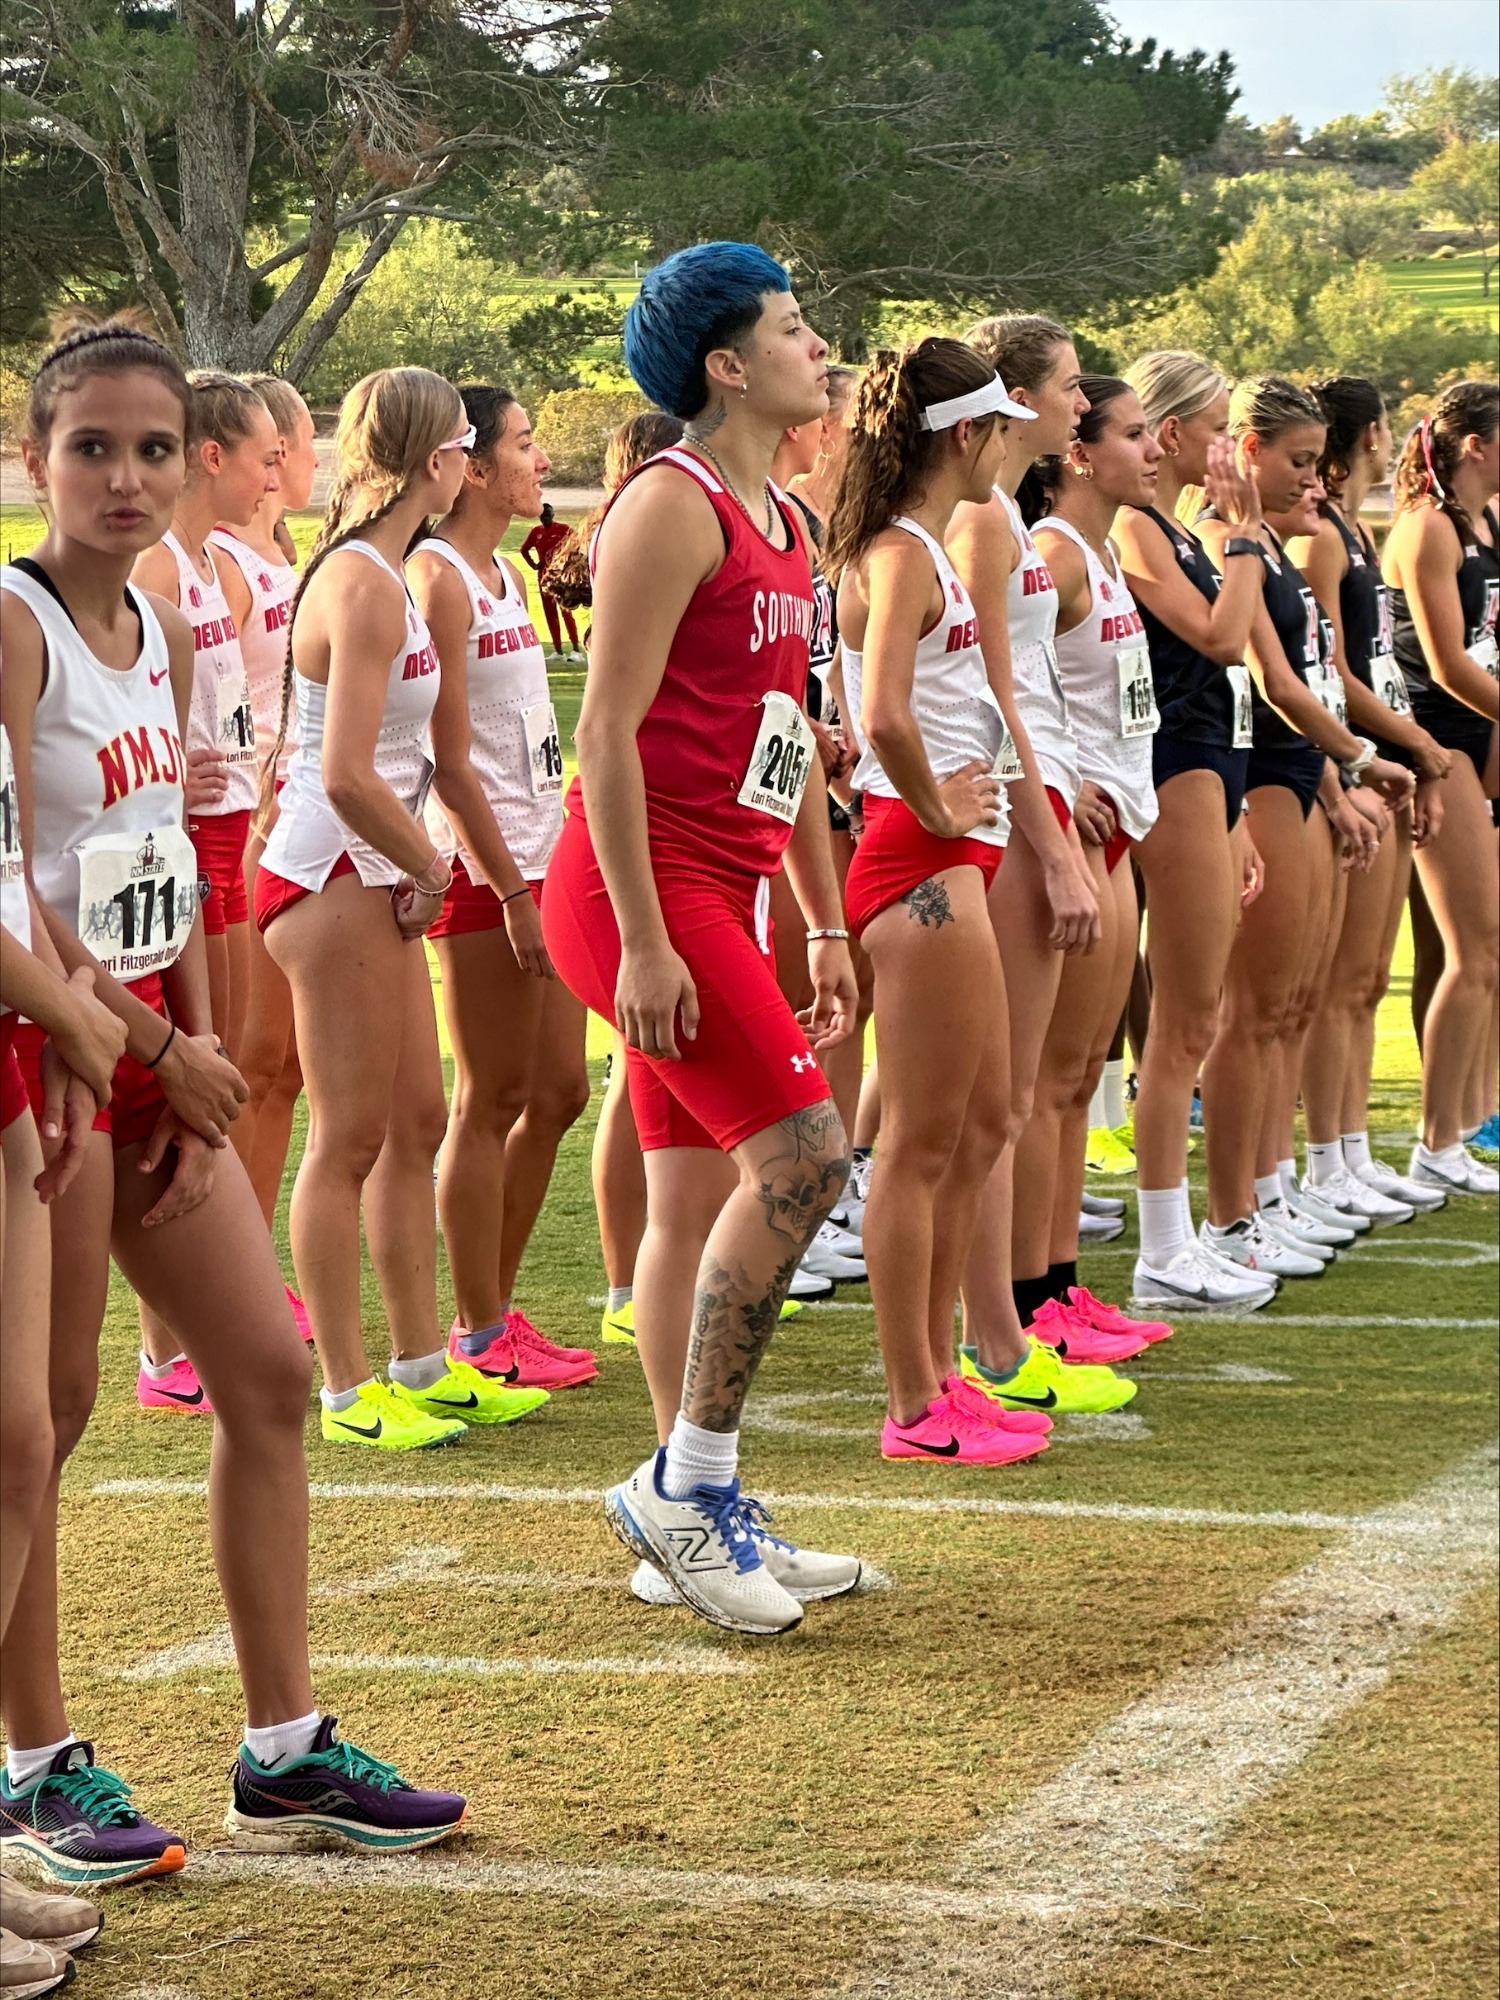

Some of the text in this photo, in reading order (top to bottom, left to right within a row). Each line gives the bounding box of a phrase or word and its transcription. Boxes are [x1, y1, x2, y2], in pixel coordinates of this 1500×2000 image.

[478, 627, 520, 659] NEW
[760, 734, 805, 800] 205
[113, 876, 175, 949] 171
[101, 956, 117, 972] ori
[120, 948, 165, 971] Fitzgerald
